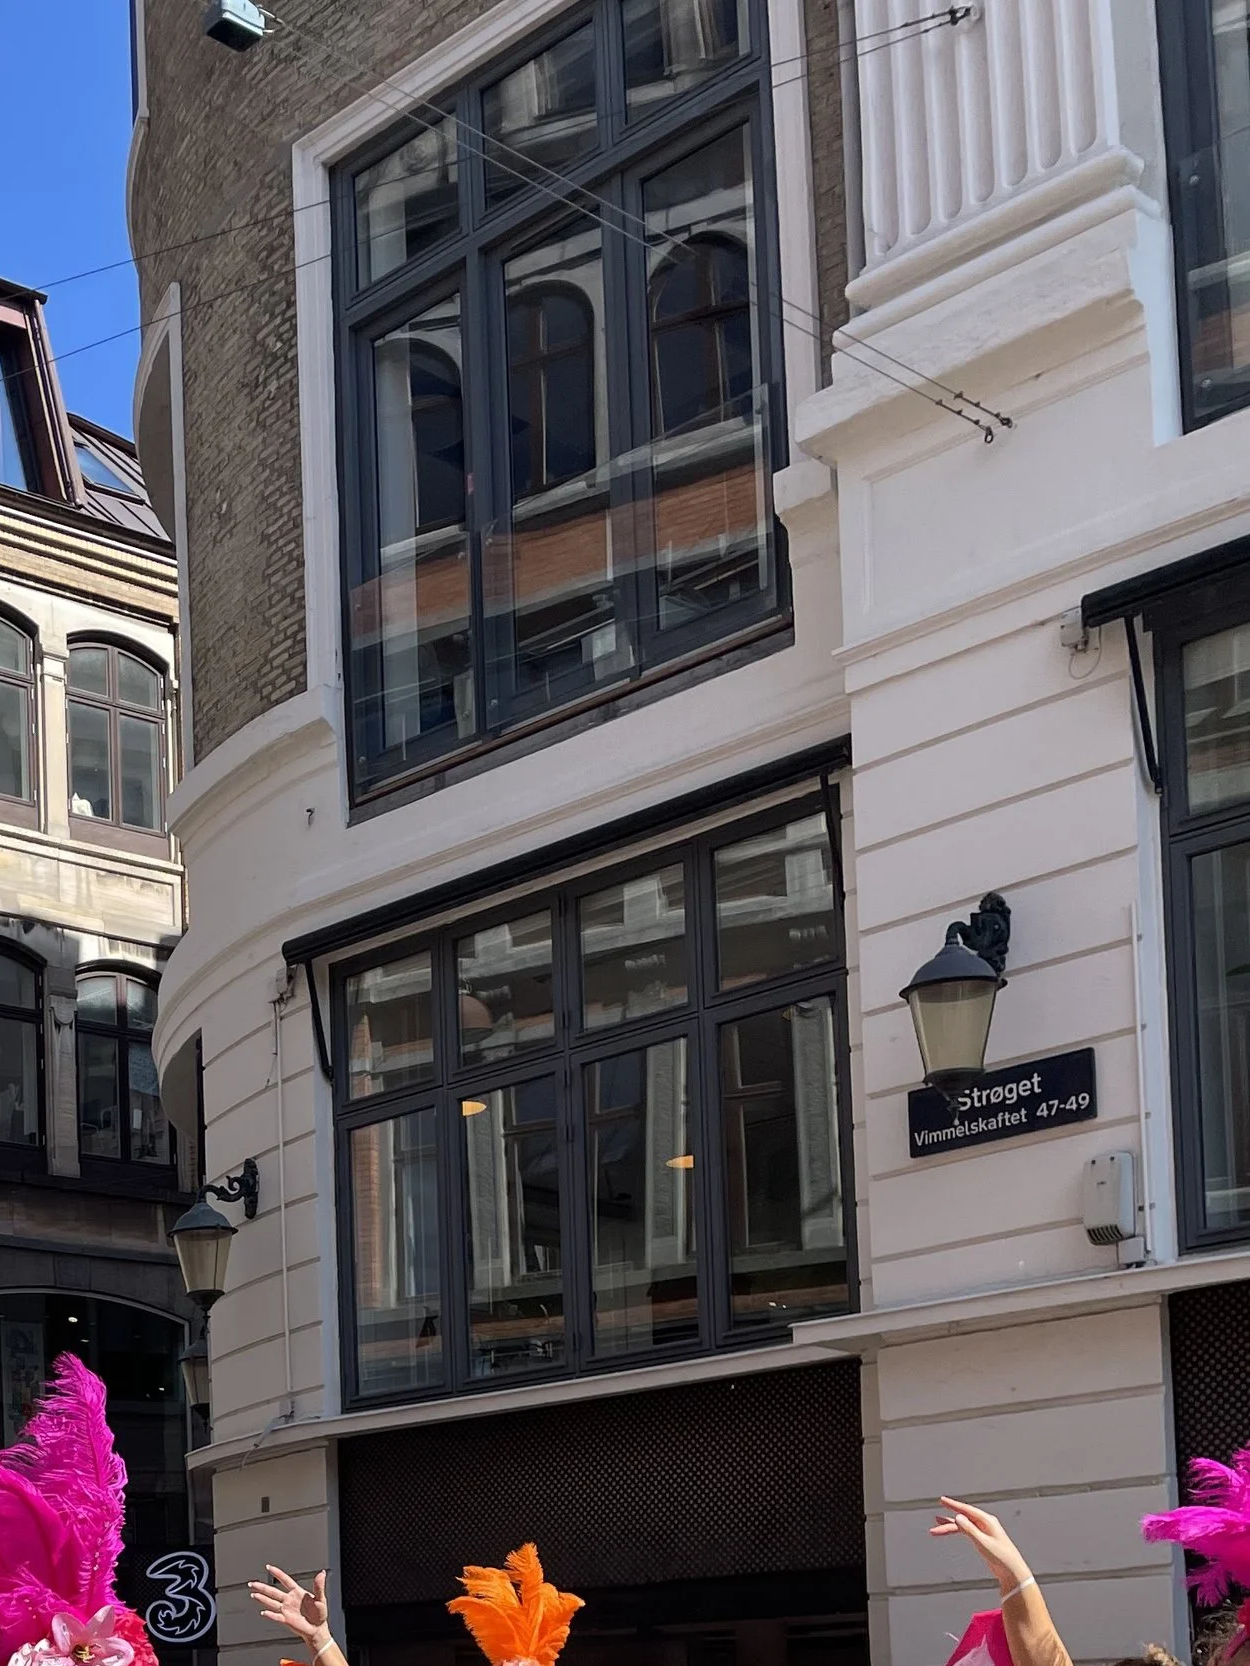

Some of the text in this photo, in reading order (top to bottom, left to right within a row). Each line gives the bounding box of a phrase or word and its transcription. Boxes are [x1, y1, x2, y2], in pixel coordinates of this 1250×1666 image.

[957, 1072, 1042, 1111] Strøget
[914, 1092, 1091, 1147] Vimmelskaftet 47-49
